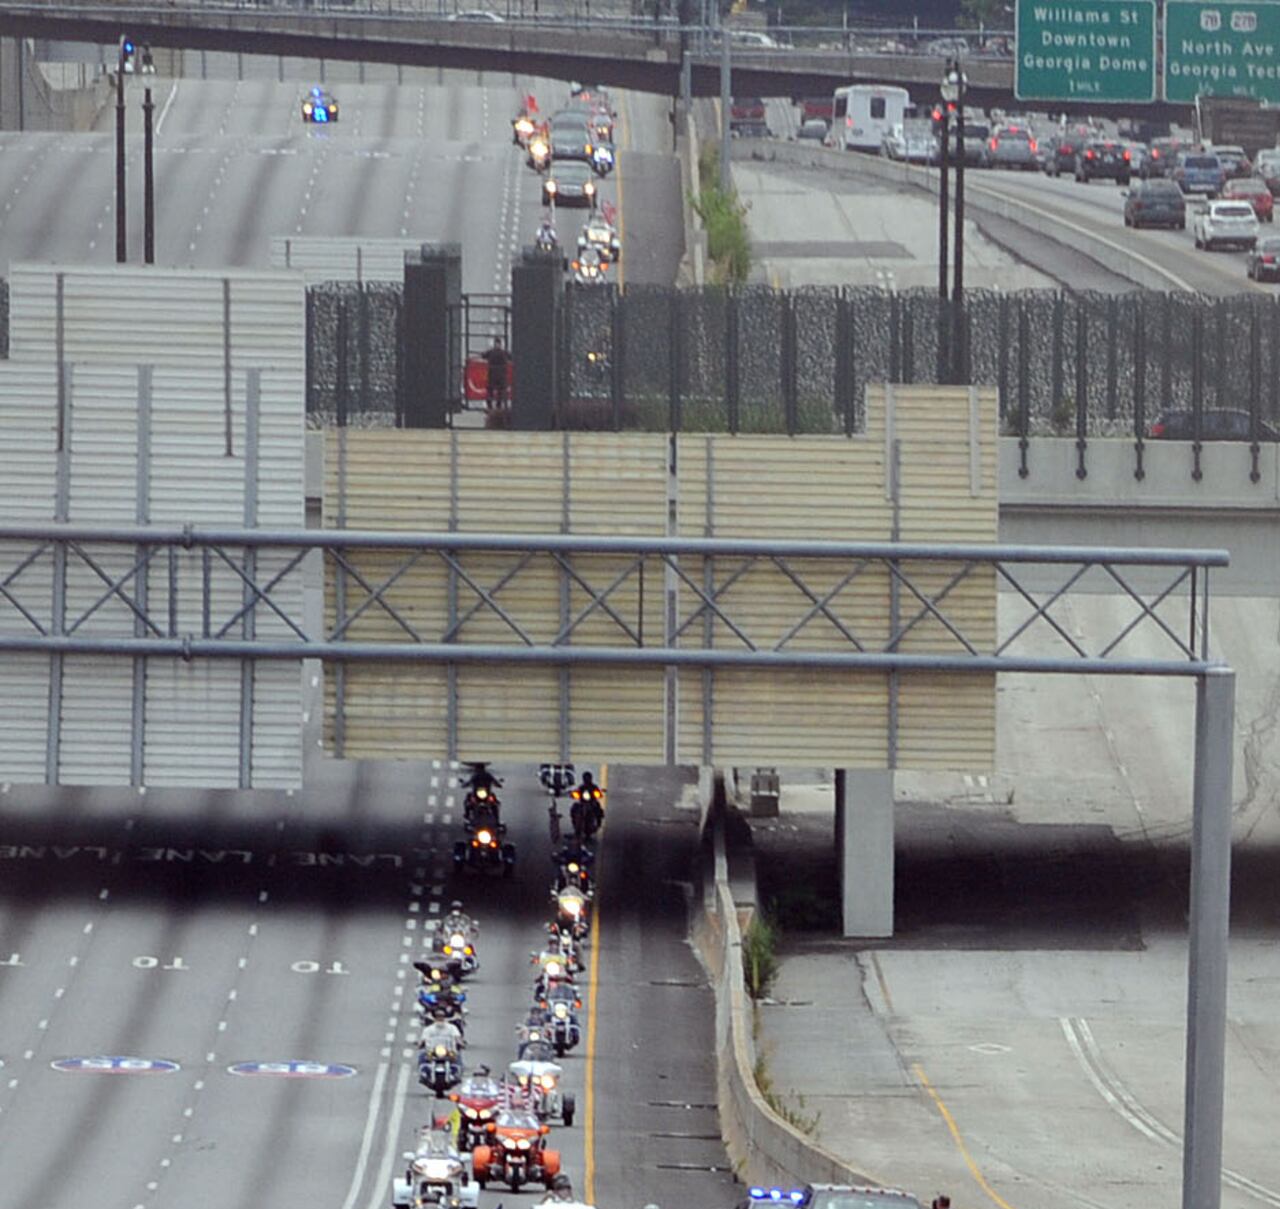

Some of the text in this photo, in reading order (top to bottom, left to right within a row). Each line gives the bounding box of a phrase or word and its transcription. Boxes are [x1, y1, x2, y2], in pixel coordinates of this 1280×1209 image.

[1034, 8, 1138, 24] Williams St
[1042, 31, 1130, 48] Downtown
[1182, 40, 1273, 56] North Ave
[1024, 54, 1147, 73] Georgia Dome
[1170, 63, 1236, 81] Georgia
[132, 956, 189, 971] TO
[291, 961, 350, 974] TO
